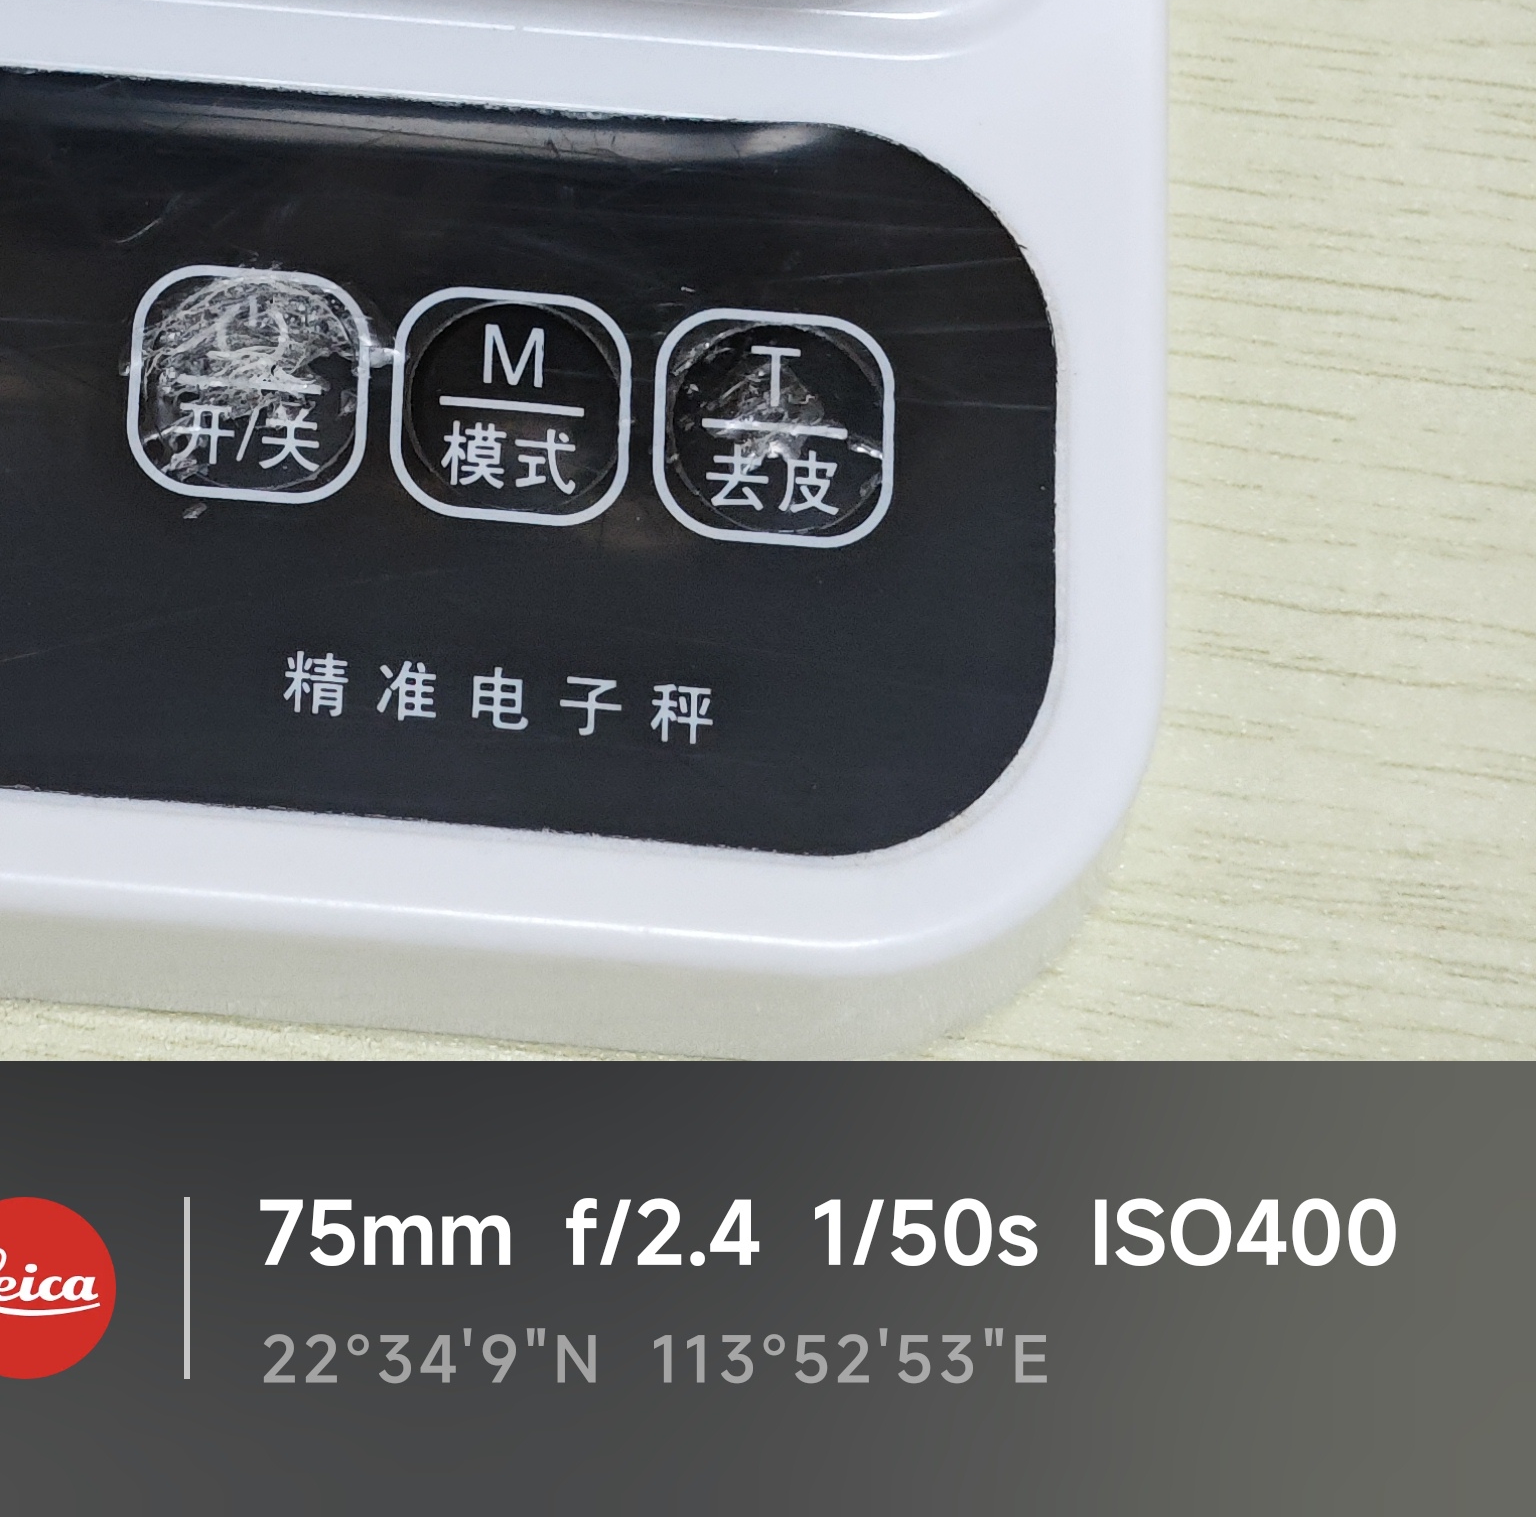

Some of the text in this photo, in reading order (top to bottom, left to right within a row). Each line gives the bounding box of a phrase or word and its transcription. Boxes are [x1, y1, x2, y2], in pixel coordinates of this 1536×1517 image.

[483, 323, 545, 388] M
[750, 345, 802, 407] T
[178, 403, 321, 471] 开/关
[440, 420, 578, 496] 模式
[704, 450, 840, 516] 去皮
[283, 650, 714, 745] 精准电子秤
